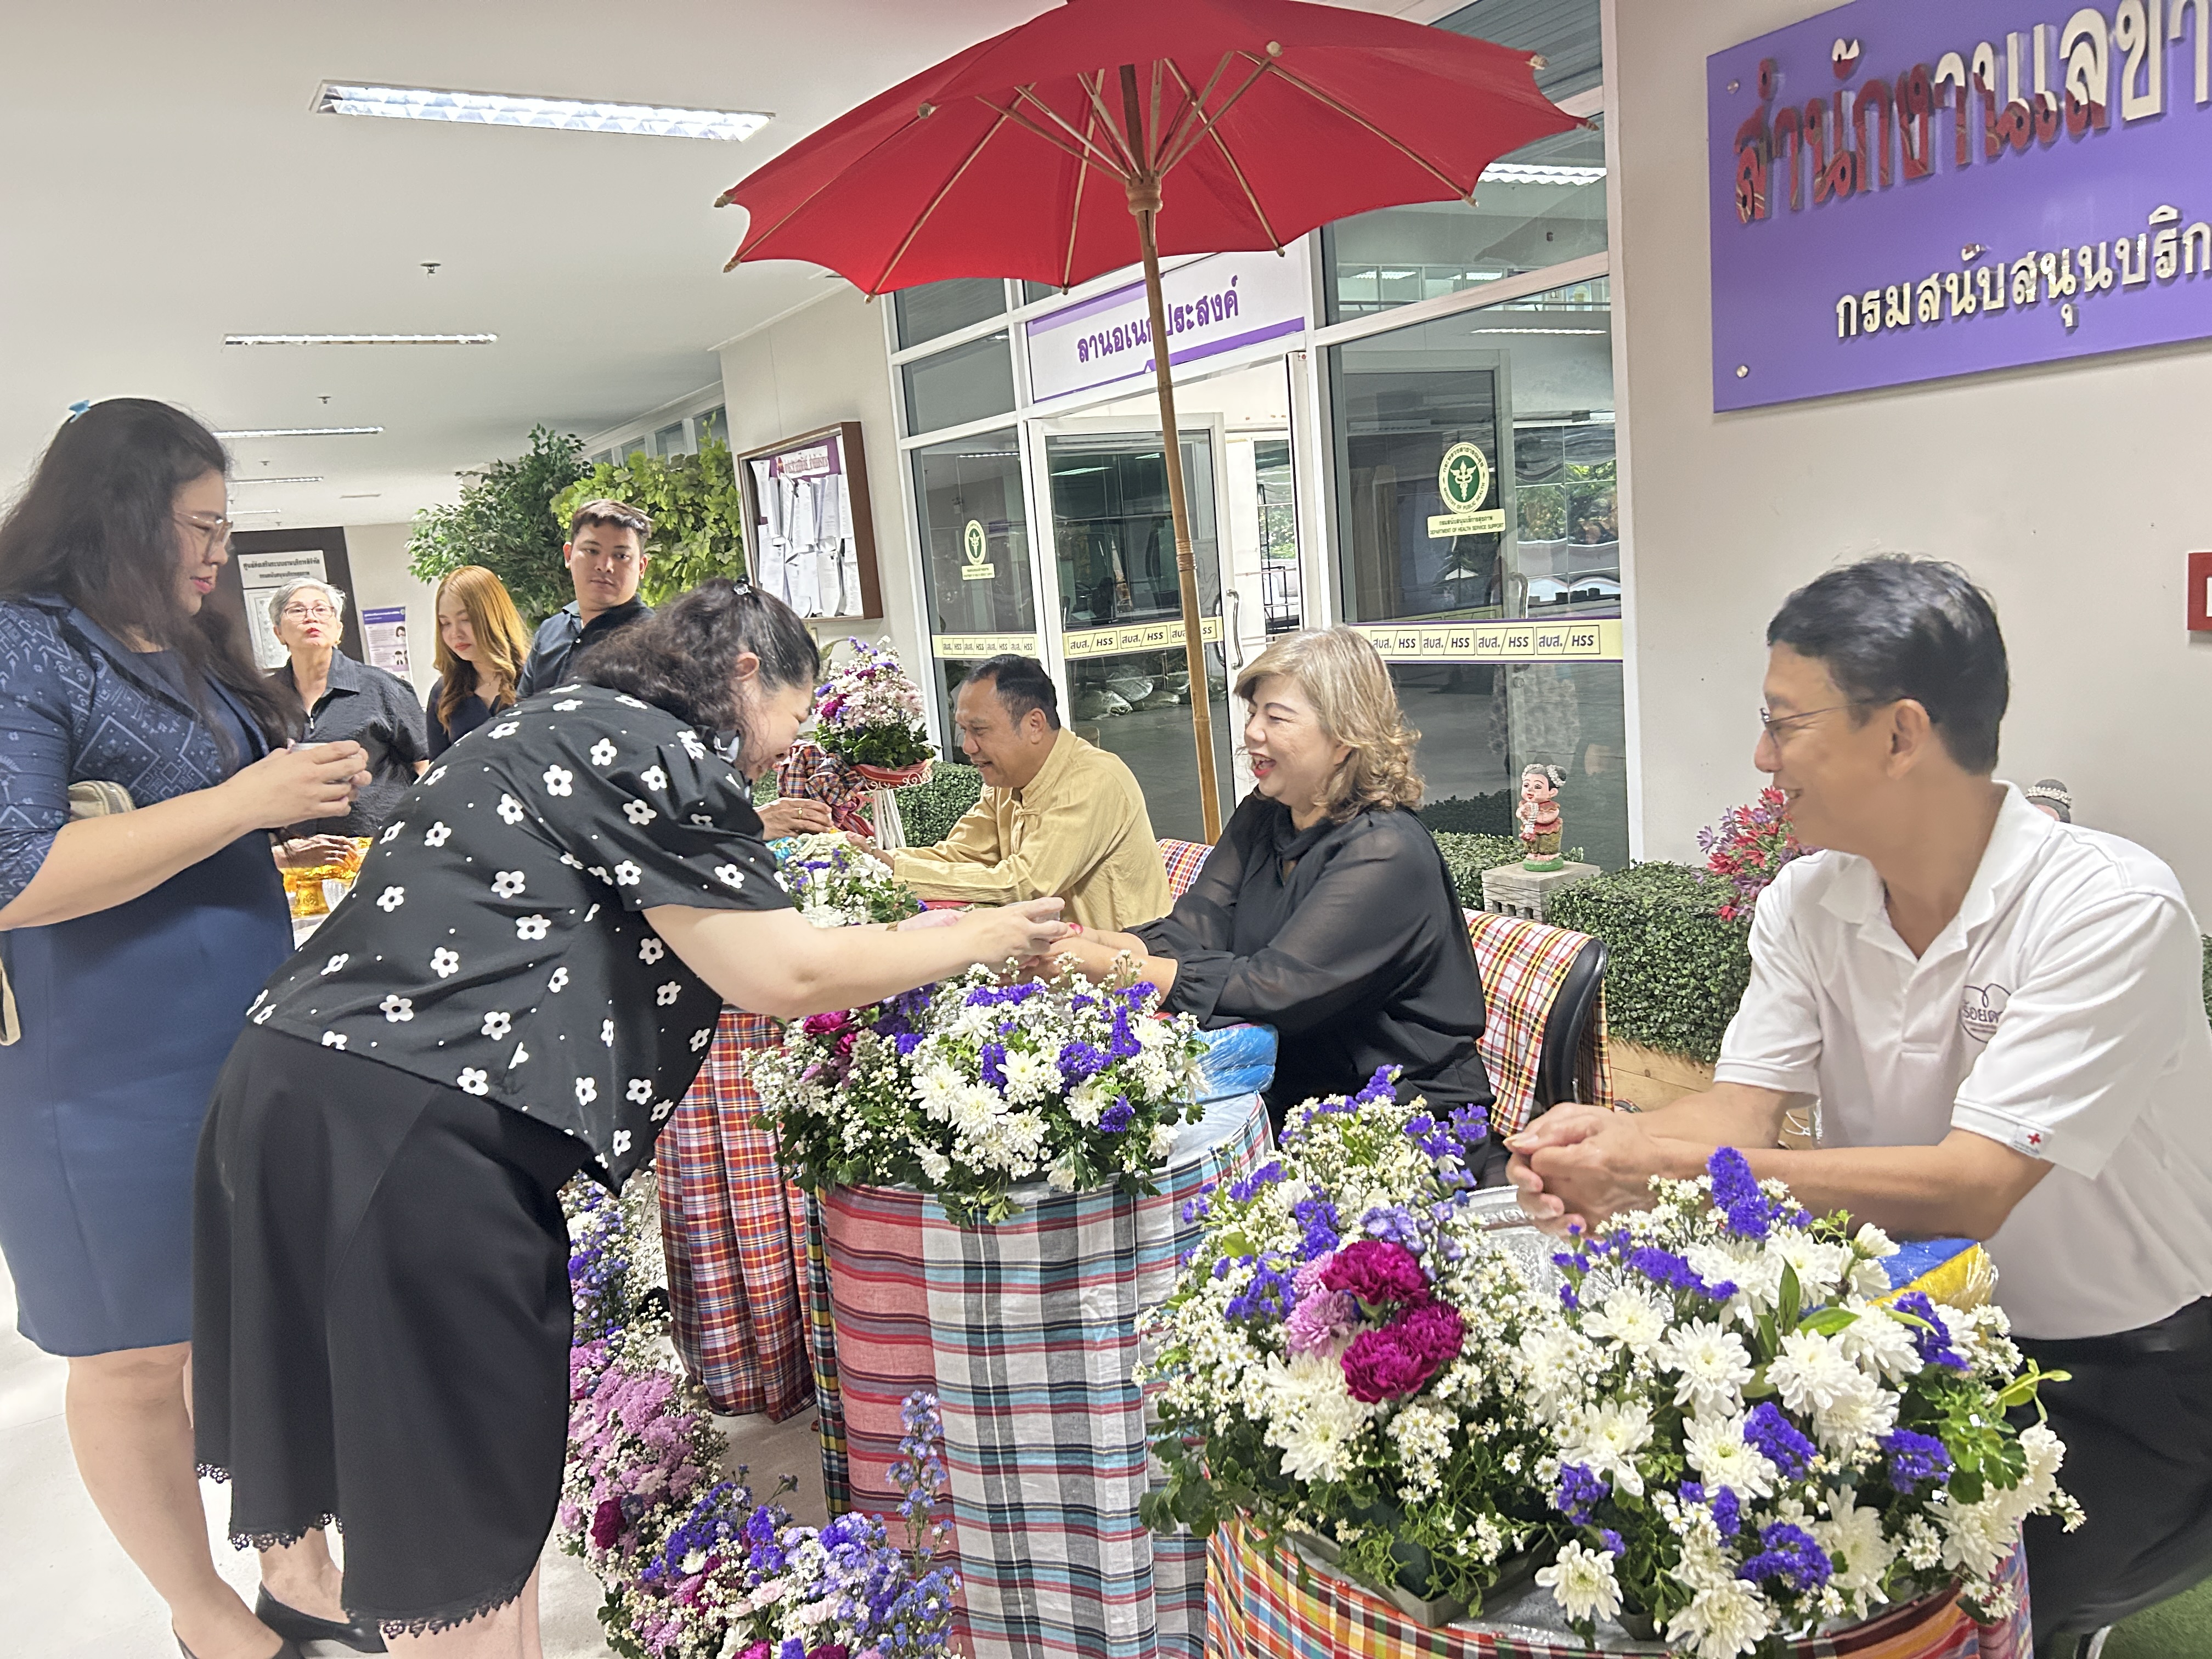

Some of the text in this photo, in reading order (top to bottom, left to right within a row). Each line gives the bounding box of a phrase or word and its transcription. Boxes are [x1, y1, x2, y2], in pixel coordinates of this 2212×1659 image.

[1836, 205, 2211, 338] กรมสนับสนุนบริก
[1443, 487, 1456, 506] MINISTRY
[1463, 500, 1476, 510] PUBLIC
[1475, 483, 1486, 501] HEALTH
[1097, 637, 1113, 647] HSS
[1147, 631, 1164, 641] HSS
[1203, 627, 1212, 635] SS
[1398, 638, 1415, 648] HSS
[1423, 637, 1443, 648] สบส.
[1451, 637, 1470, 648] HSS
[1478, 636, 1500, 648] สบส.
[1508, 636, 1529, 647] HSS
[1538, 635, 1563, 647] สบส.
[1572, 635, 1594, 646] HSS
